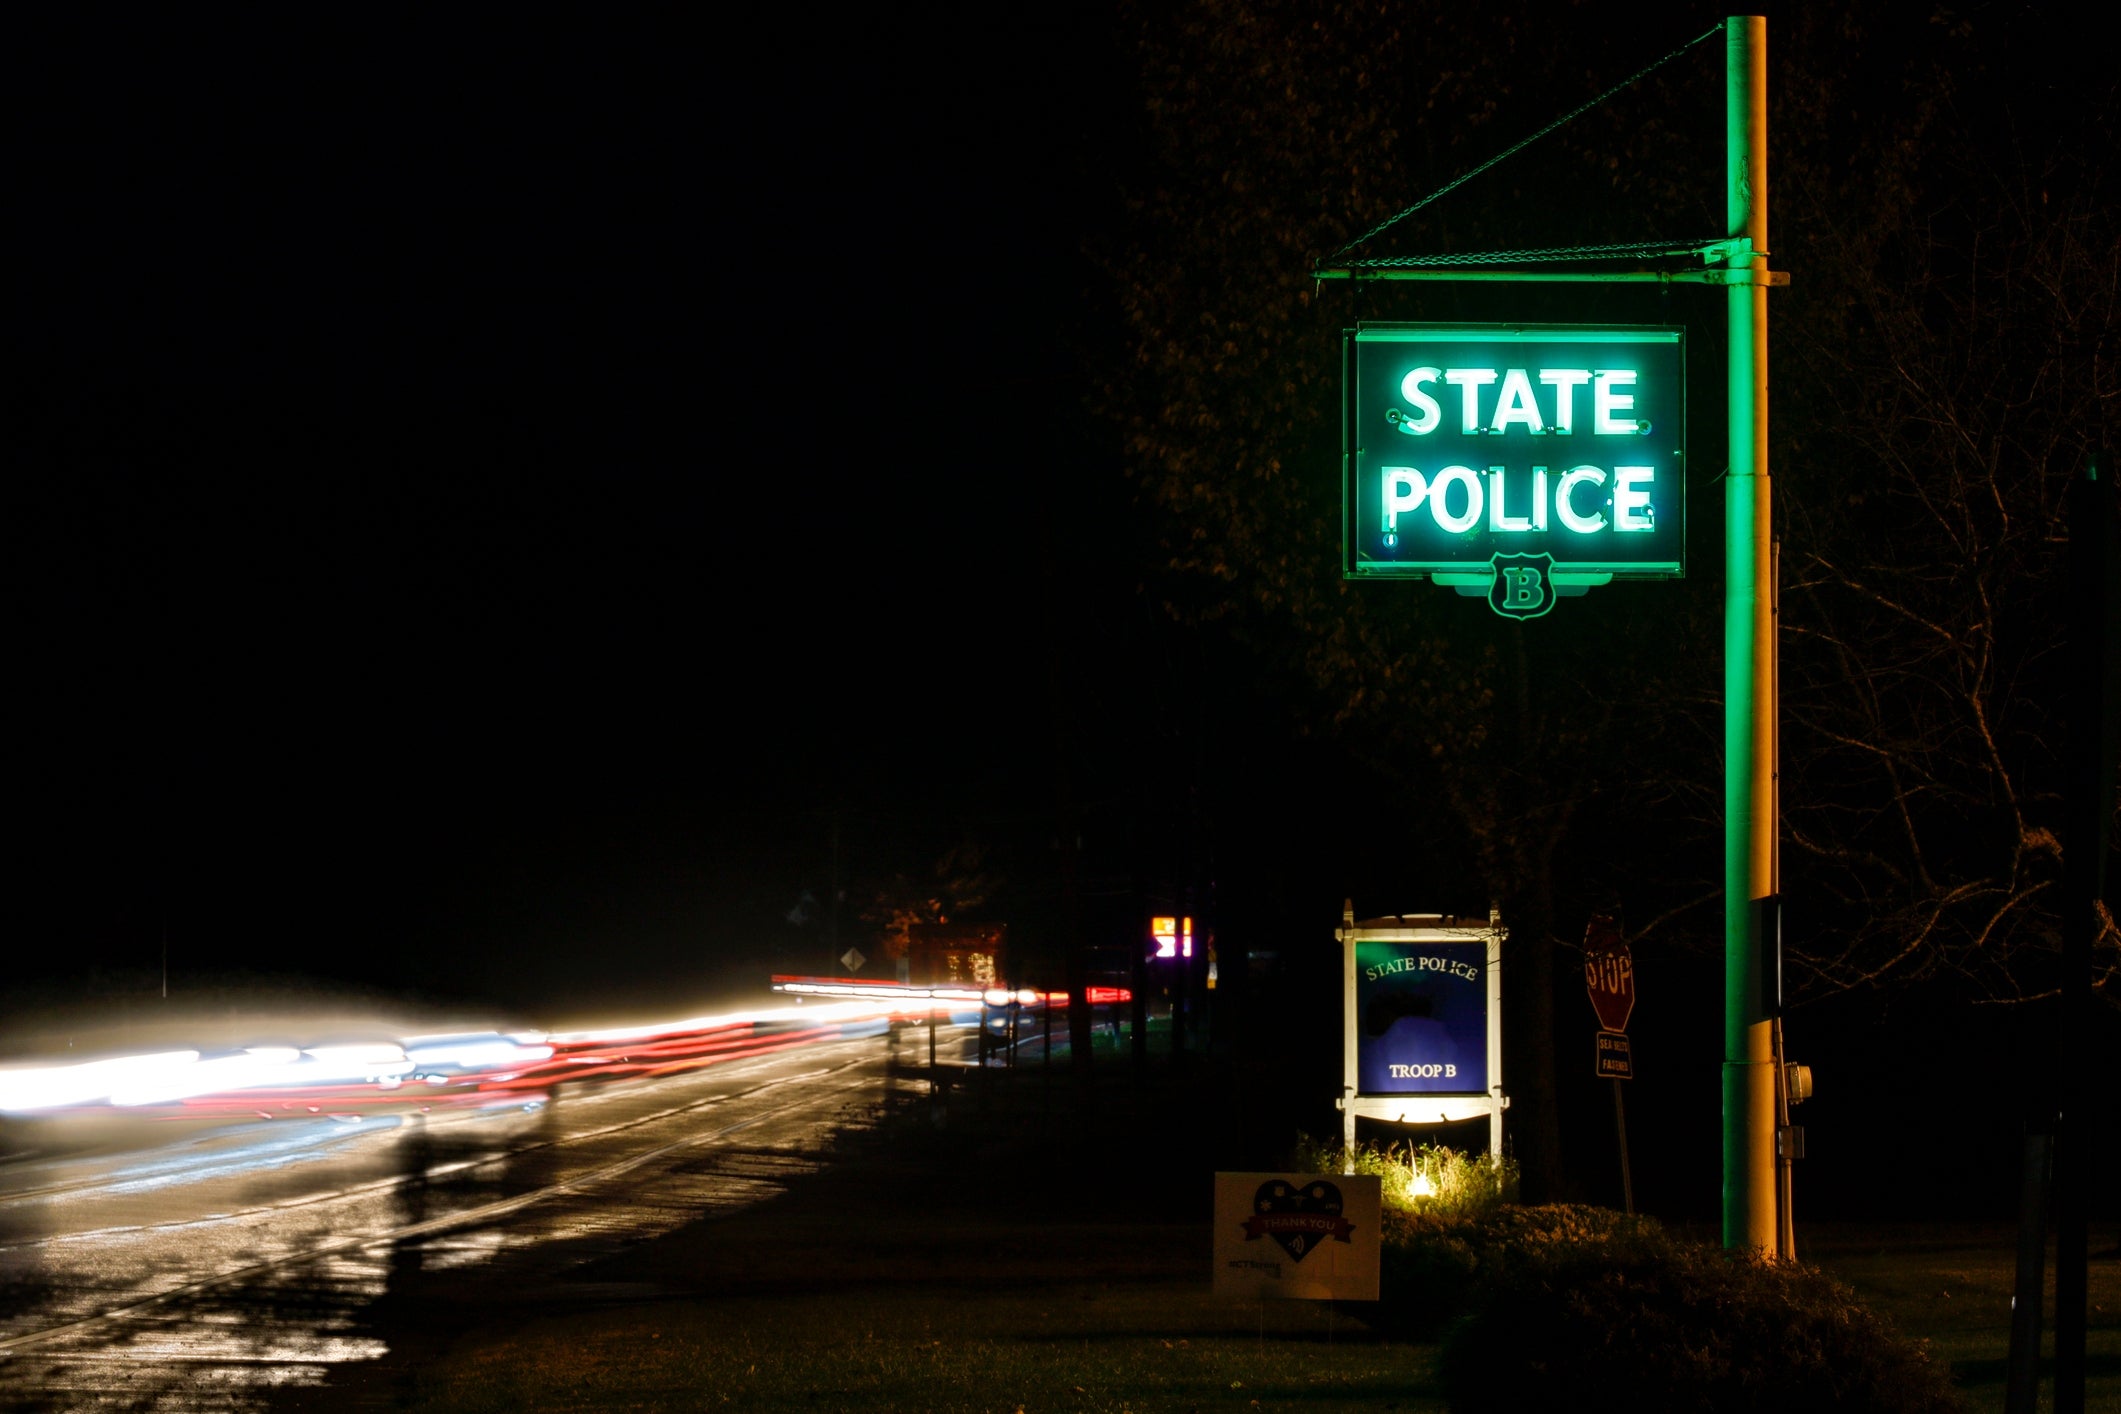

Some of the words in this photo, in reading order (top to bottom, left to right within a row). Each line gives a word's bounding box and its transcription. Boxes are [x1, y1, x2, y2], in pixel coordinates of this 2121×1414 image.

[1398, 367, 1638, 435] STATE
[1381, 465, 1655, 534] POLICE
[1502, 567, 1545, 609] B
[1366, 957, 1415, 981] STATE
[1418, 957, 1478, 981] POLICE
[1586, 951, 1629, 995] STOP
[1389, 1064, 1443, 1078] TROOP
[1445, 1064, 1457, 1078] B
[1264, 1218, 1307, 1228] THANK
[1310, 1218, 1336, 1230] YOU
